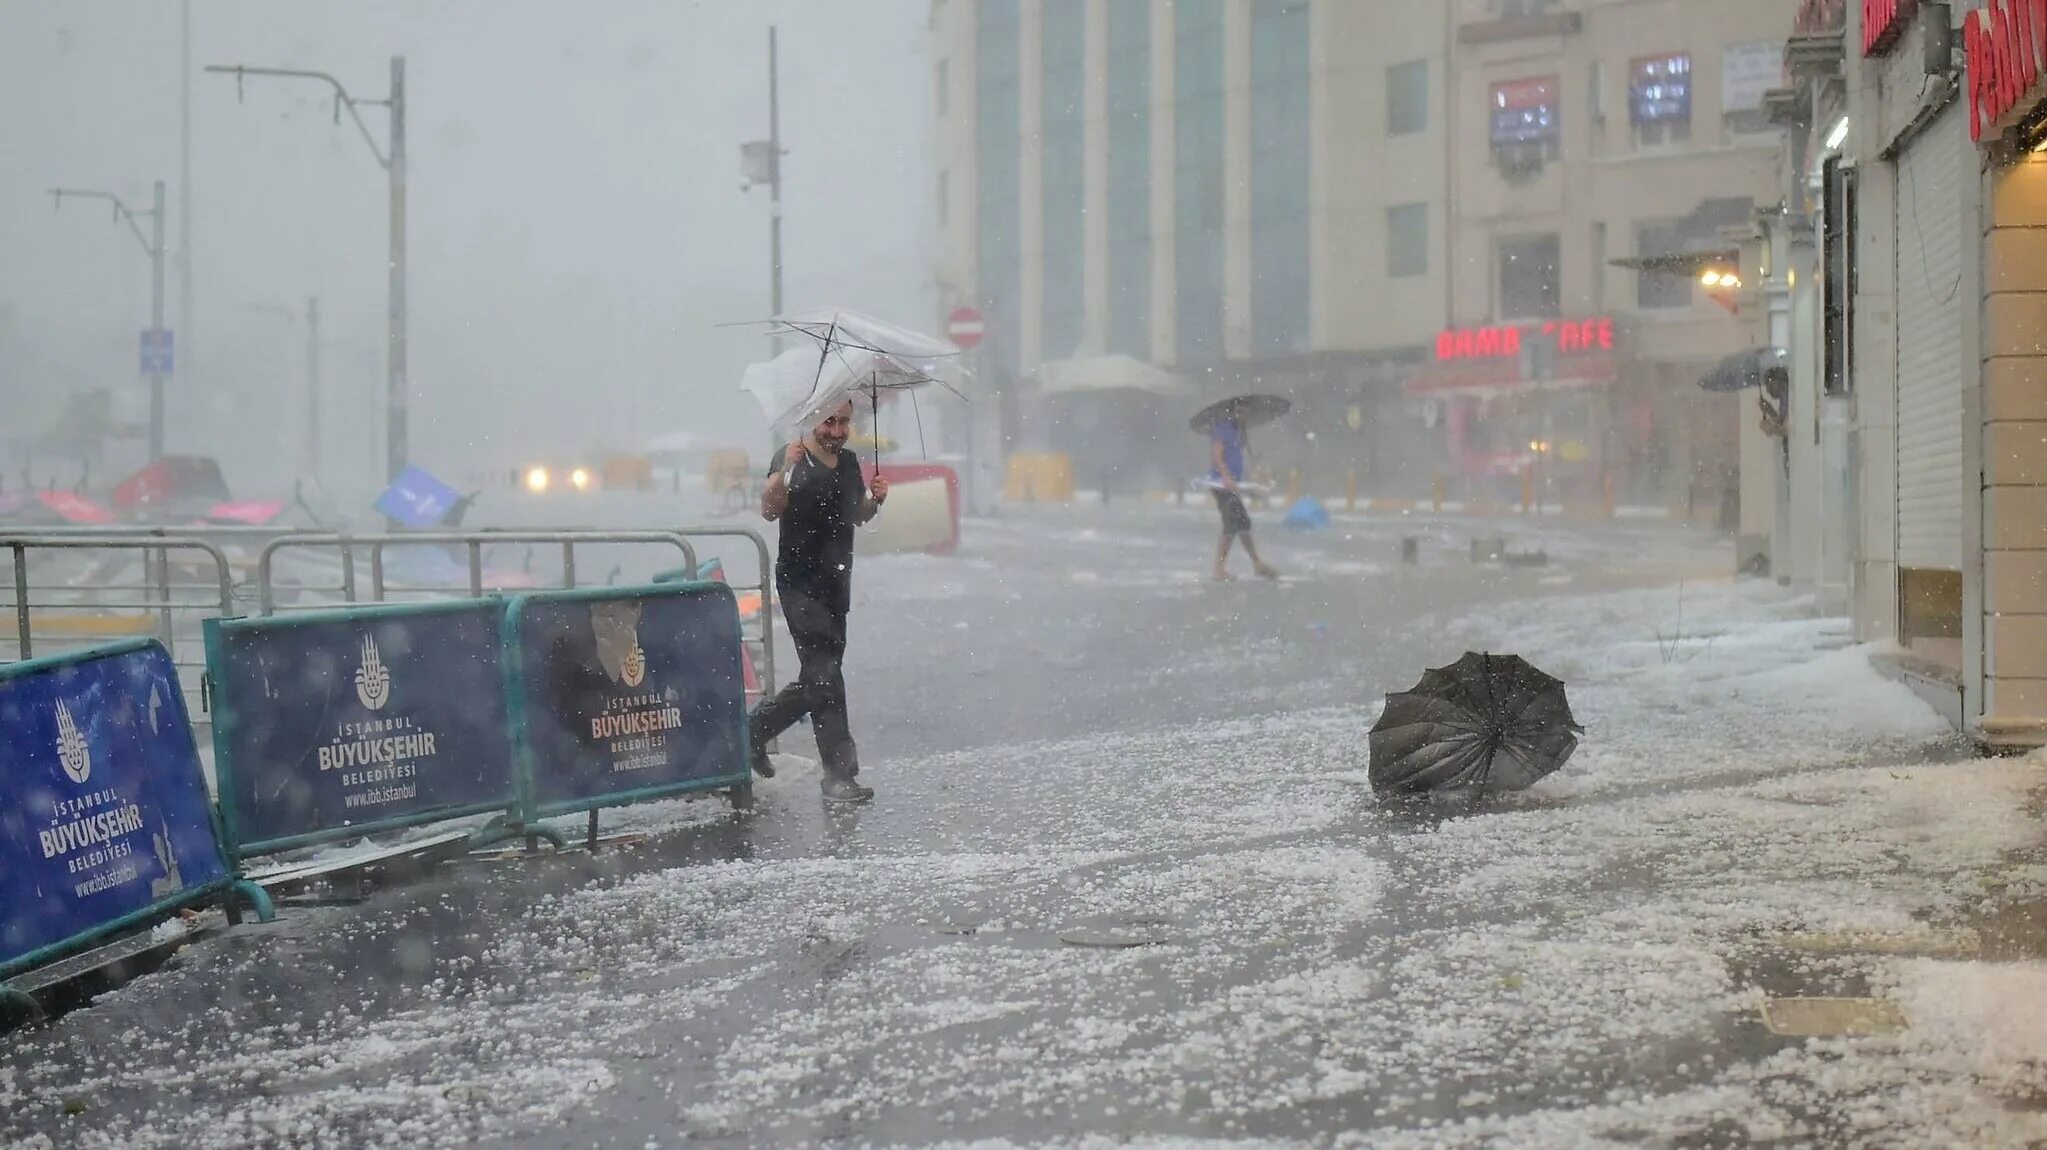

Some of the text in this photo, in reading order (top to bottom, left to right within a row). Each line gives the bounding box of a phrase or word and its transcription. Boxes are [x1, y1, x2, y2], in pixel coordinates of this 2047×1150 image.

[1436, 325, 1524, 360] BAMB
[338, 716, 412, 737] İSTANBUL
[591, 702, 682, 739] BÜYÜKŞEHİR
[318, 727, 436, 771] BÜYÜKŞEHİR
[342, 760, 416, 786] BELEDİYESİ
[52, 788, 118, 817] İSTANBUL
[344, 781, 416, 808] www.ibb.istanbul
[39, 798, 143, 859] BÜYÜKŞEHİR
[68, 838, 132, 873] BELEDİYESİ
